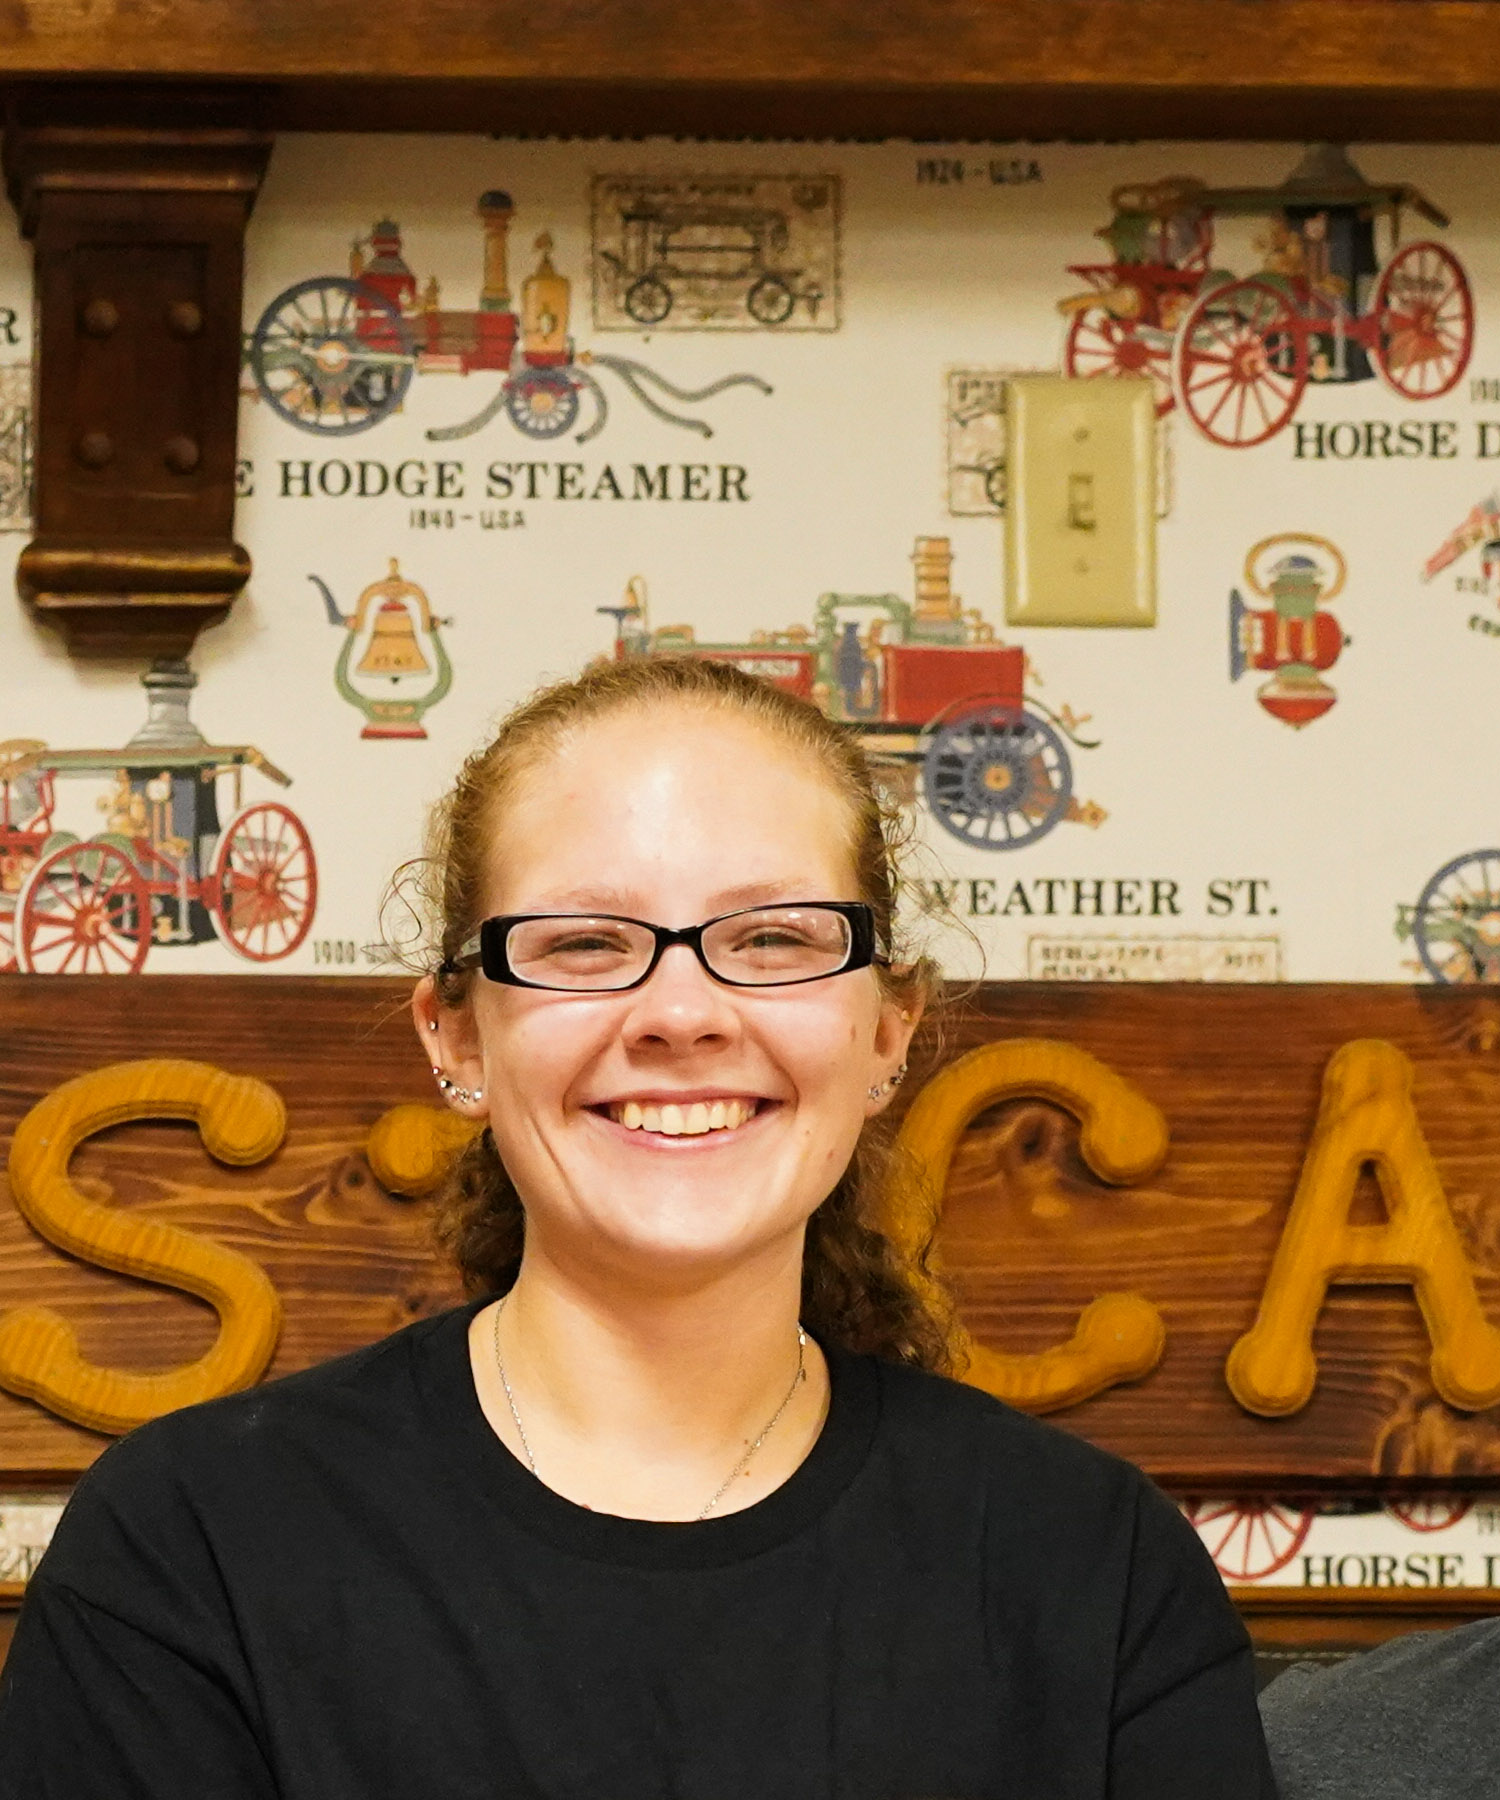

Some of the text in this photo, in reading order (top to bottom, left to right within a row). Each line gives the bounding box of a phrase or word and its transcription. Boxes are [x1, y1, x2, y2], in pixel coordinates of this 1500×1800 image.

[1293, 422, 1458, 461] HORSE
[277, 461, 464, 500] HODGE
[485, 462, 751, 502] STEAMER
[916, 879, 1279, 916] WEATHER ST.
[1304, 1554, 1464, 1588] HORSE
